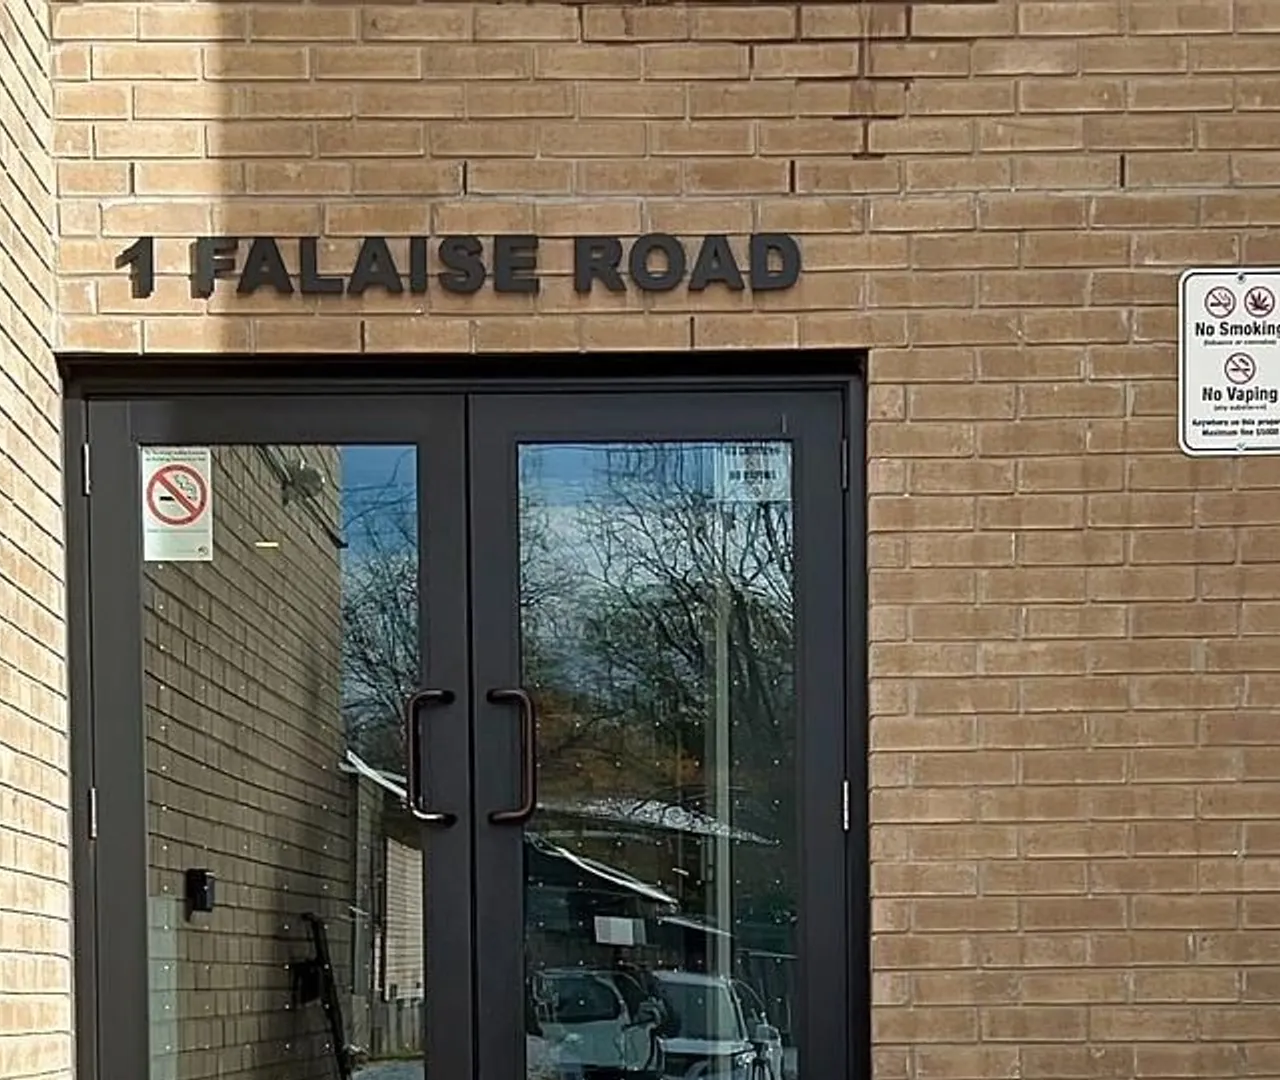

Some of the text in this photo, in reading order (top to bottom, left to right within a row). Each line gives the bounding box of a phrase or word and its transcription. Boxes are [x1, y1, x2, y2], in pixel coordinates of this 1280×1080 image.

[114, 232, 801, 299] 1 FALAISE ROAD
[1195, 321, 1215, 337] No
[1202, 386, 1278, 404] No Vaping
